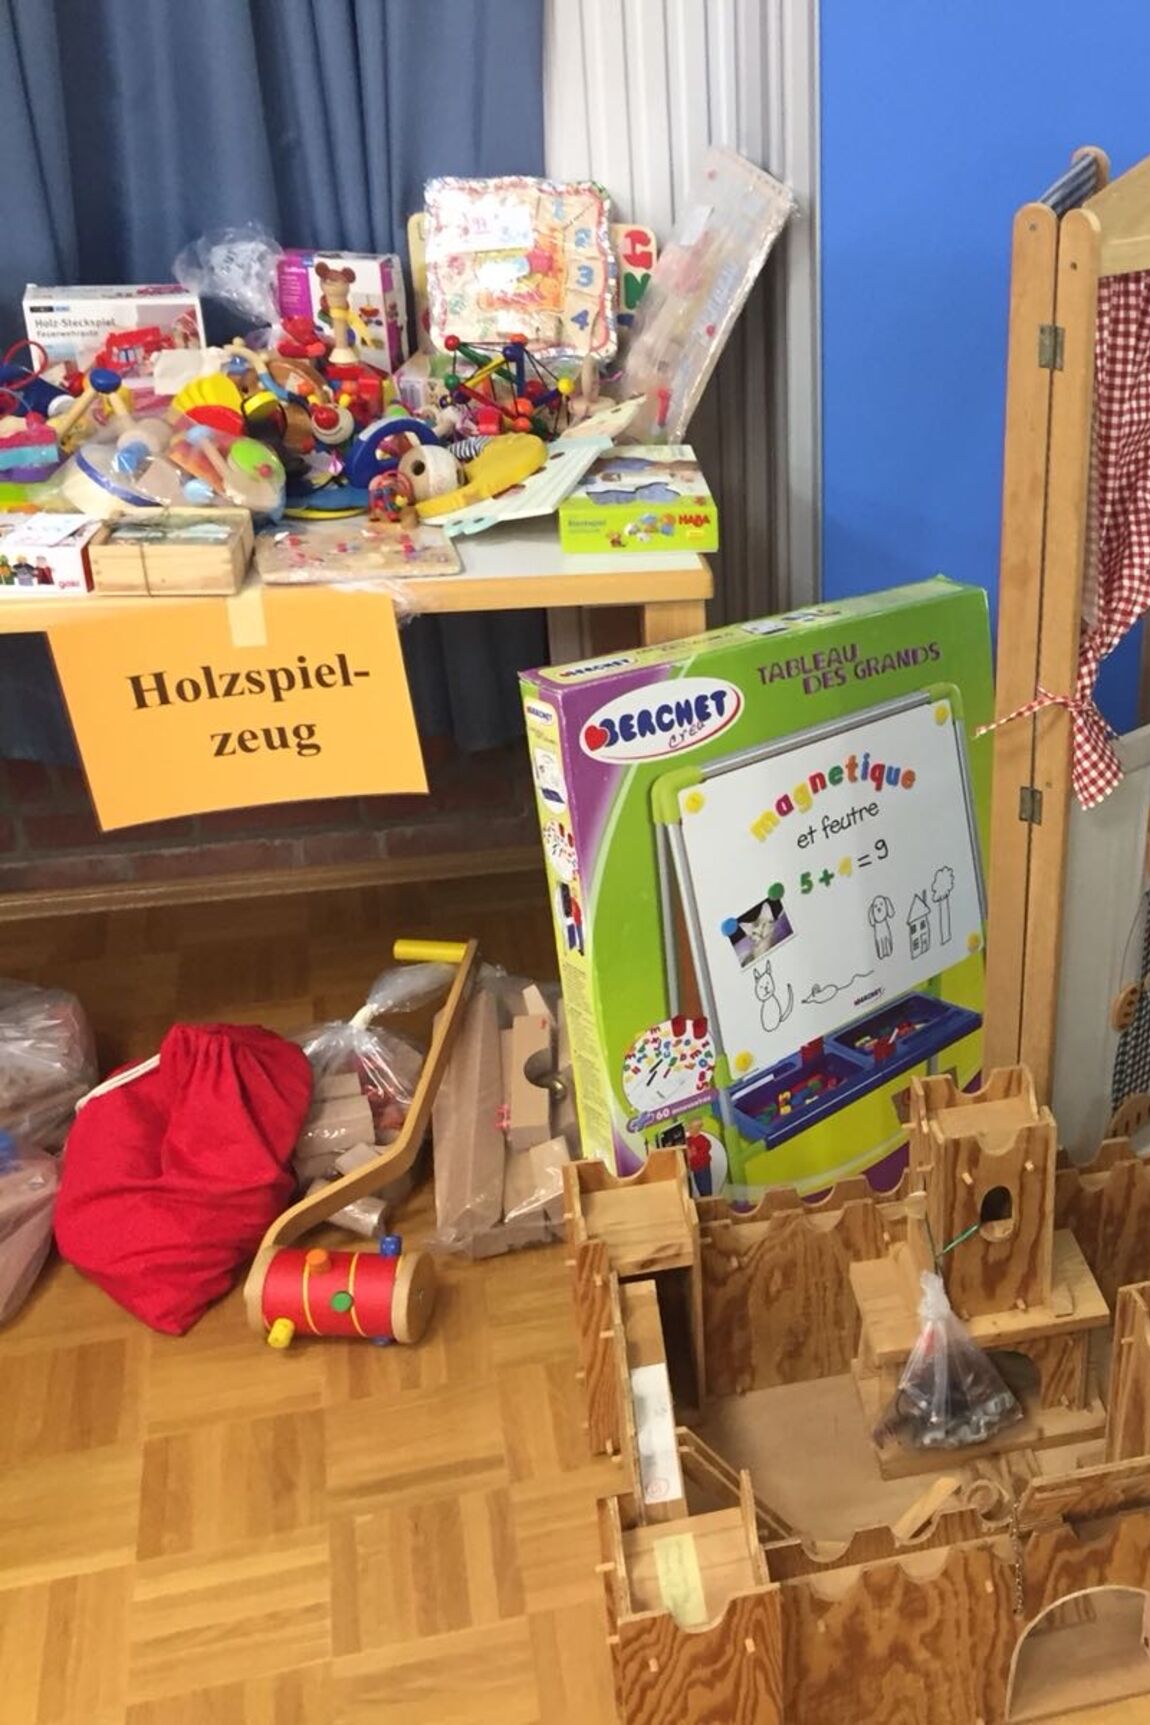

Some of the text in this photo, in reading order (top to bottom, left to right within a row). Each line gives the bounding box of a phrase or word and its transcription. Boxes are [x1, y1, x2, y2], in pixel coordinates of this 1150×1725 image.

[576, 264, 594, 287] 3
[570, 309, 590, 331] 4
[678, 513, 710, 528] HABA
[127, 653, 370, 710] Holzspiel-
[757, 643, 859, 686] TABLEAU
[803, 641, 941, 696] DES GRANDS
[210, 723, 322, 758] zeug
[599, 690, 727, 748] BERCHET
[749, 752, 916, 843] magnetique
[797, 802, 880, 849] et feutre
[656, 1107, 671, 1121] 60
